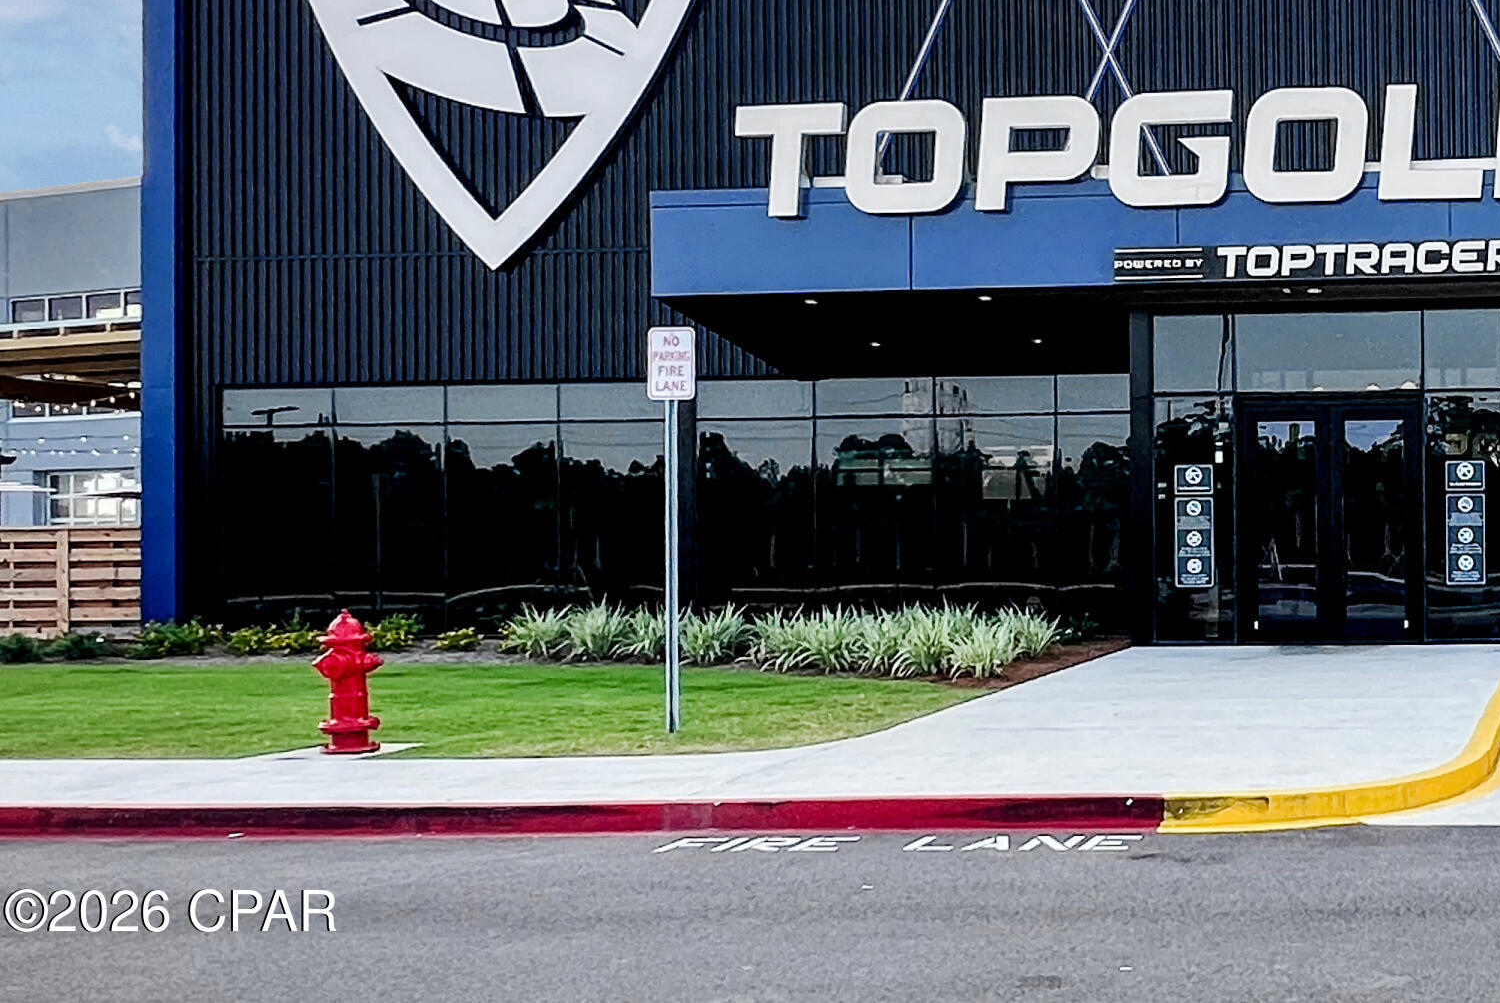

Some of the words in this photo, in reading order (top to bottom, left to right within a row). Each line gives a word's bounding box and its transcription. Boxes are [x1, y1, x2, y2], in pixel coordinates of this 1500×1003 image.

[1114, 259, 1182, 269] POWERED
[1185, 259, 1204, 268] BY
[663, 336, 680, 346] NO
[653, 351, 690, 361] PARKING
[658, 365, 685, 377] FIRE
[655, 380, 687, 392] LANE
[653, 835, 861, 853] FIRE
[902, 834, 1144, 852] LANE
